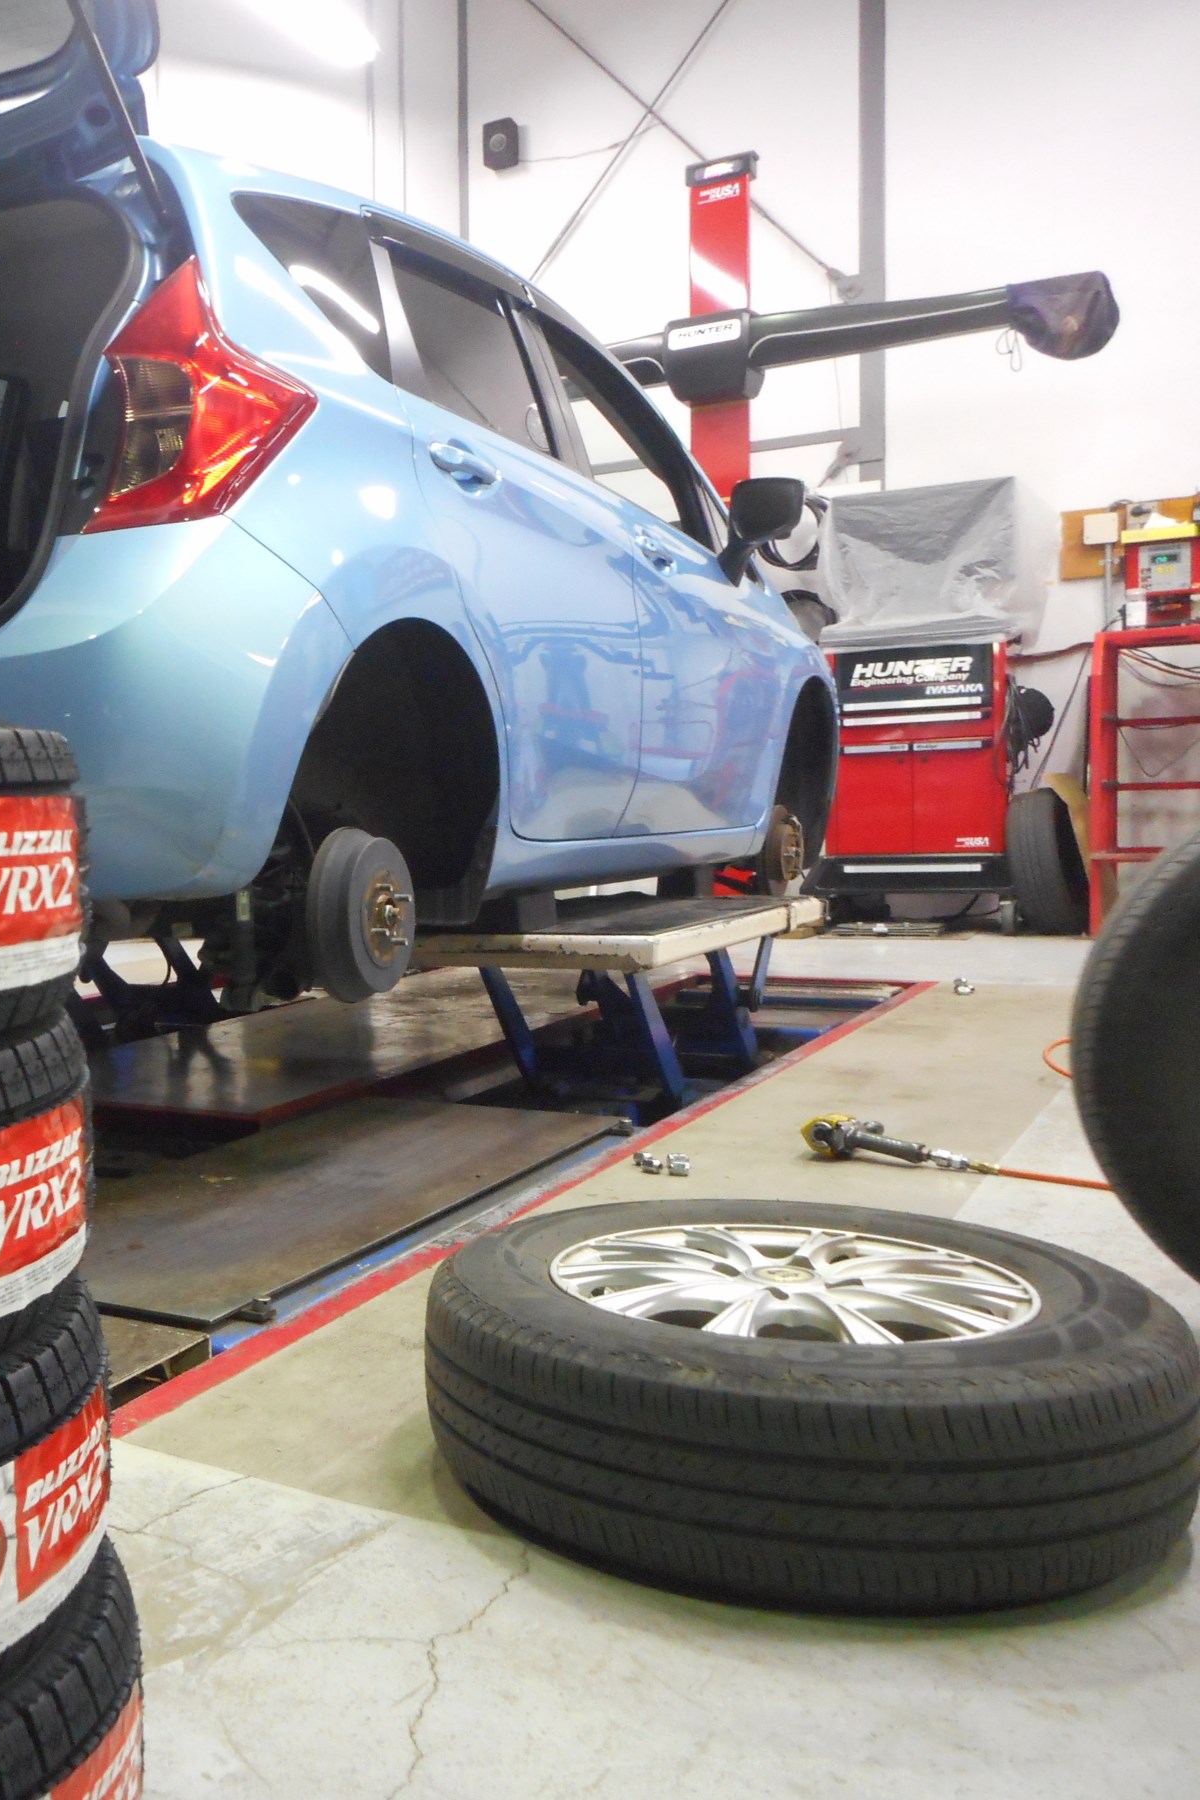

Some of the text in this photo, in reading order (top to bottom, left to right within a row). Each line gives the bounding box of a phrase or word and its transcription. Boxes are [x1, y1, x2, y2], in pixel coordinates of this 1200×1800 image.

[678, 322, 734, 339] HUNTER
[852, 656, 973, 678] HUNTER
[850, 672, 969, 688] Engineering Company
[926, 683, 984, 695] IYASAKA
[23, 1443, 106, 1572] VRX2
